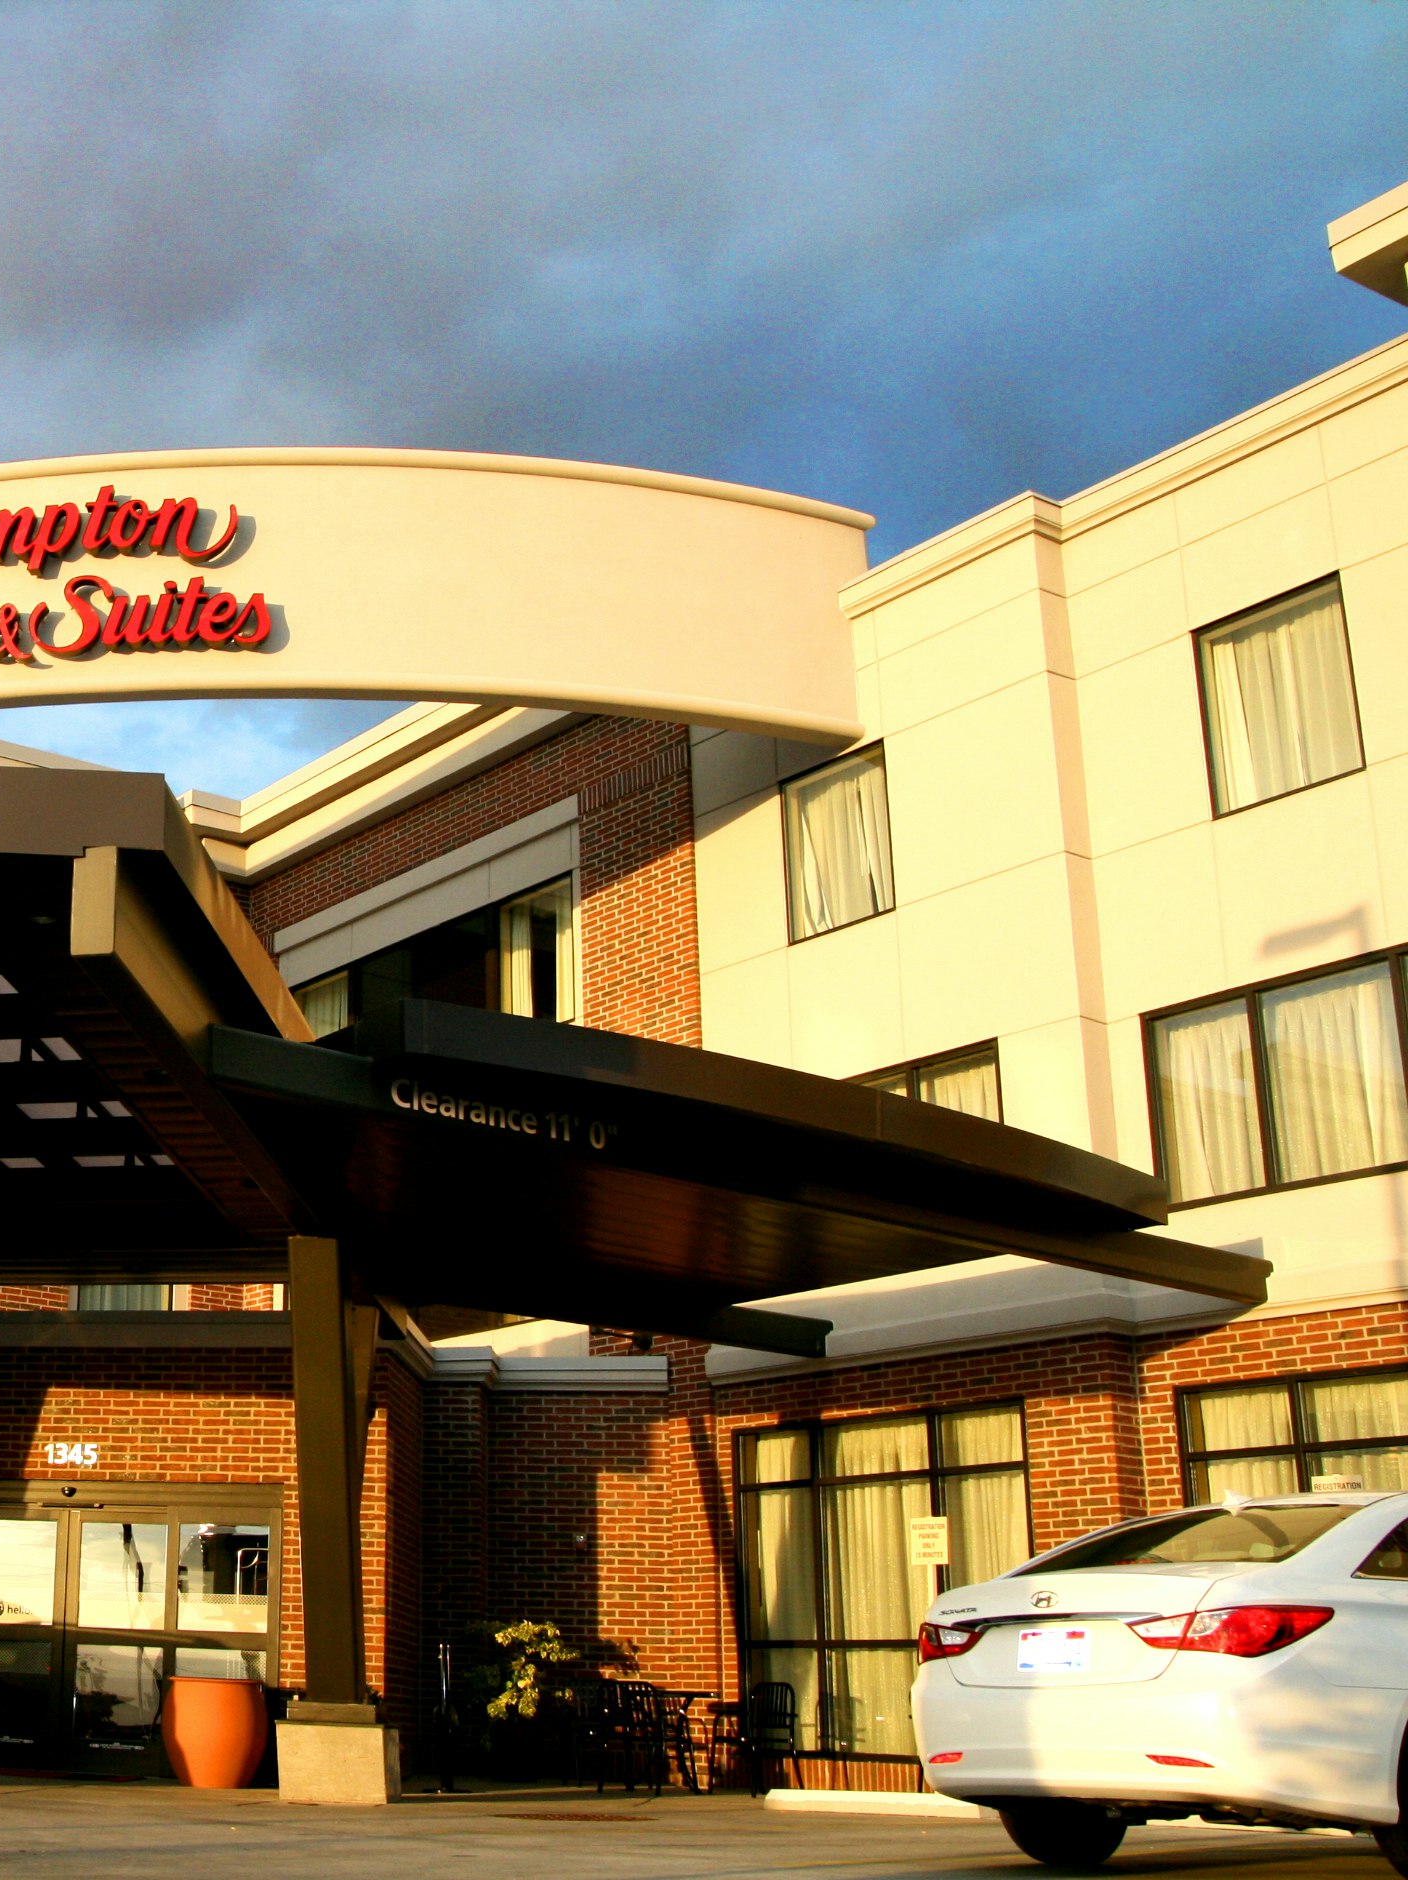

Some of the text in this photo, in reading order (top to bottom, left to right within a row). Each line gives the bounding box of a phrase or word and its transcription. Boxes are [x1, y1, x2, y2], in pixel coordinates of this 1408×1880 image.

[30, 575, 272, 661] Suites
[390, 1078, 538, 1135] Clearance
[43, 1442, 99, 1465] 1345
[1313, 1481, 1362, 1491] REGISTRATION
